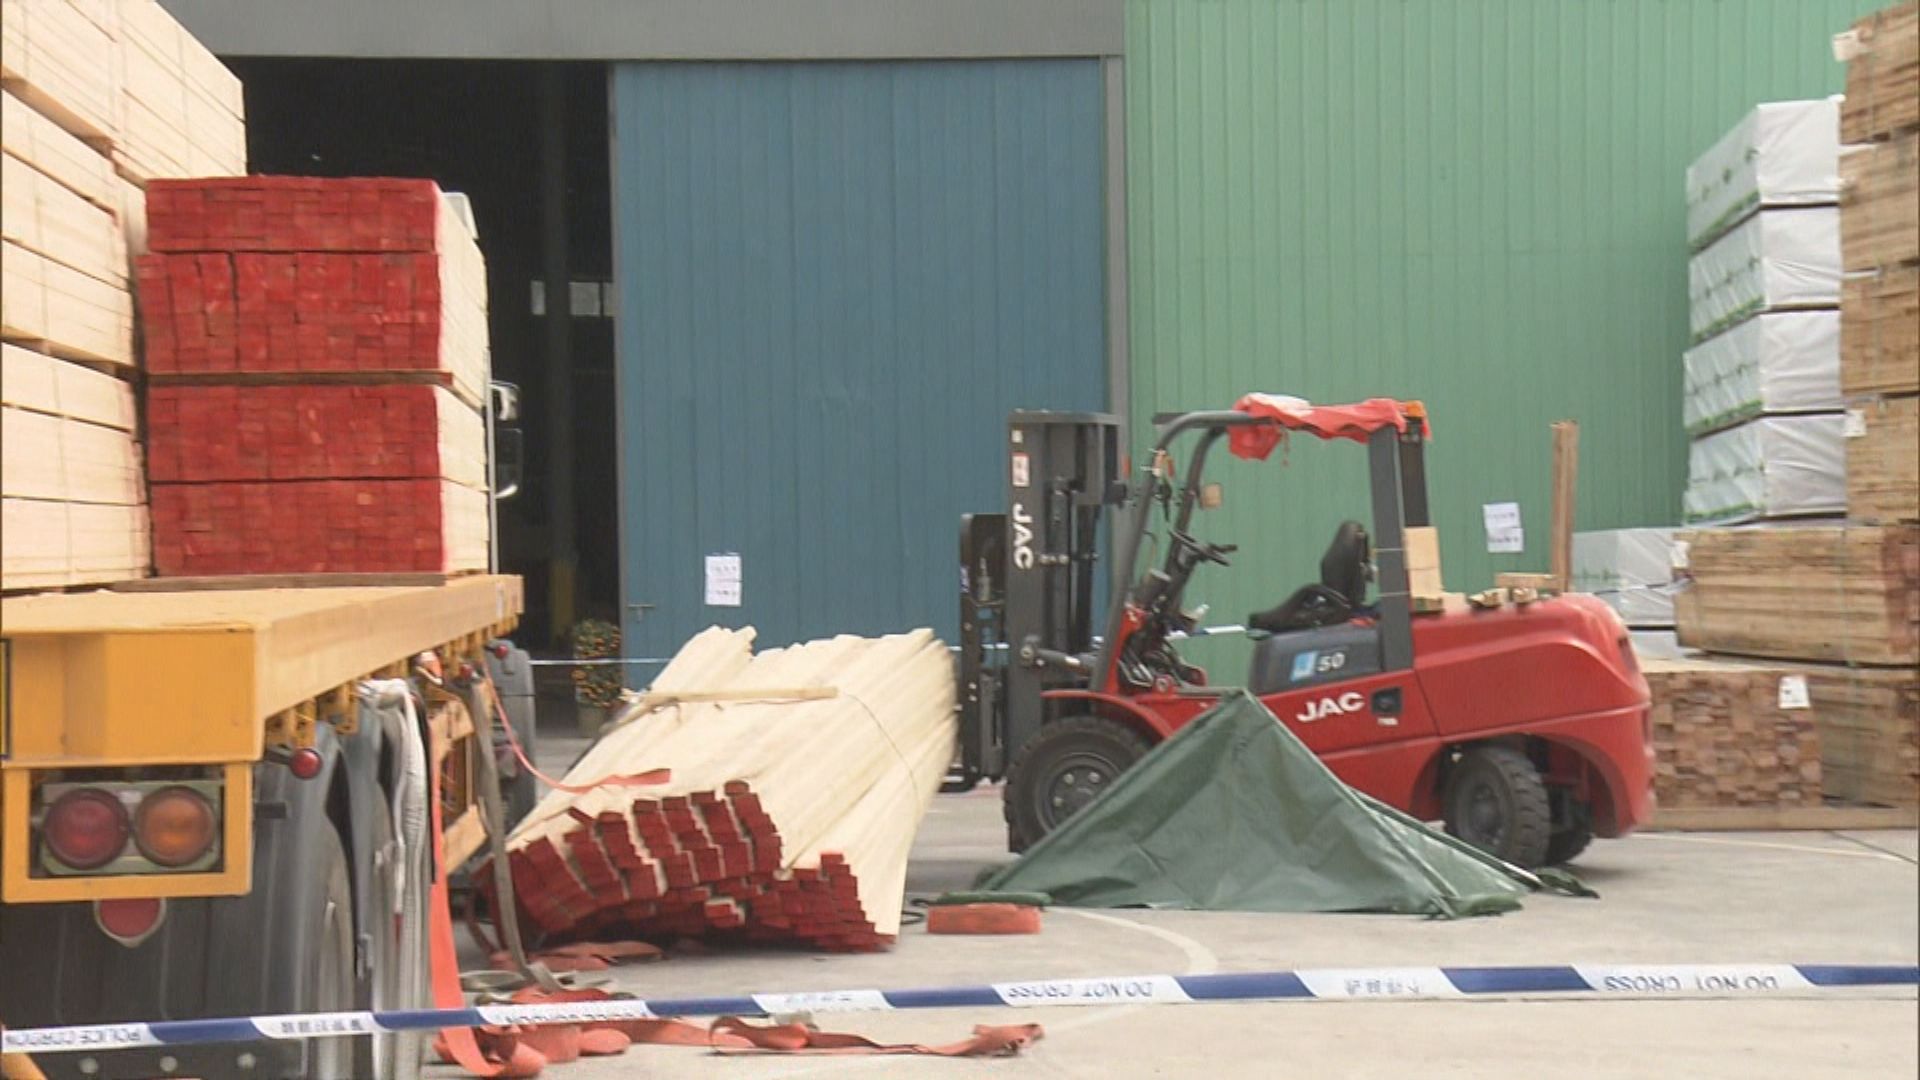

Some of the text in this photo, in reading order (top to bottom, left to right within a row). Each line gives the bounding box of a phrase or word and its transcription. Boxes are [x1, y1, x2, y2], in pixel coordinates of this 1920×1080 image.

[1012, 503, 1034, 570] JAC
[1317, 652, 1345, 672] 50
[1296, 692, 1365, 722] JAC
[1008, 984, 1072, 998] CROSS
[1603, 975, 1681, 992] CROSS
[80, 1028, 141, 1042] POLICE
